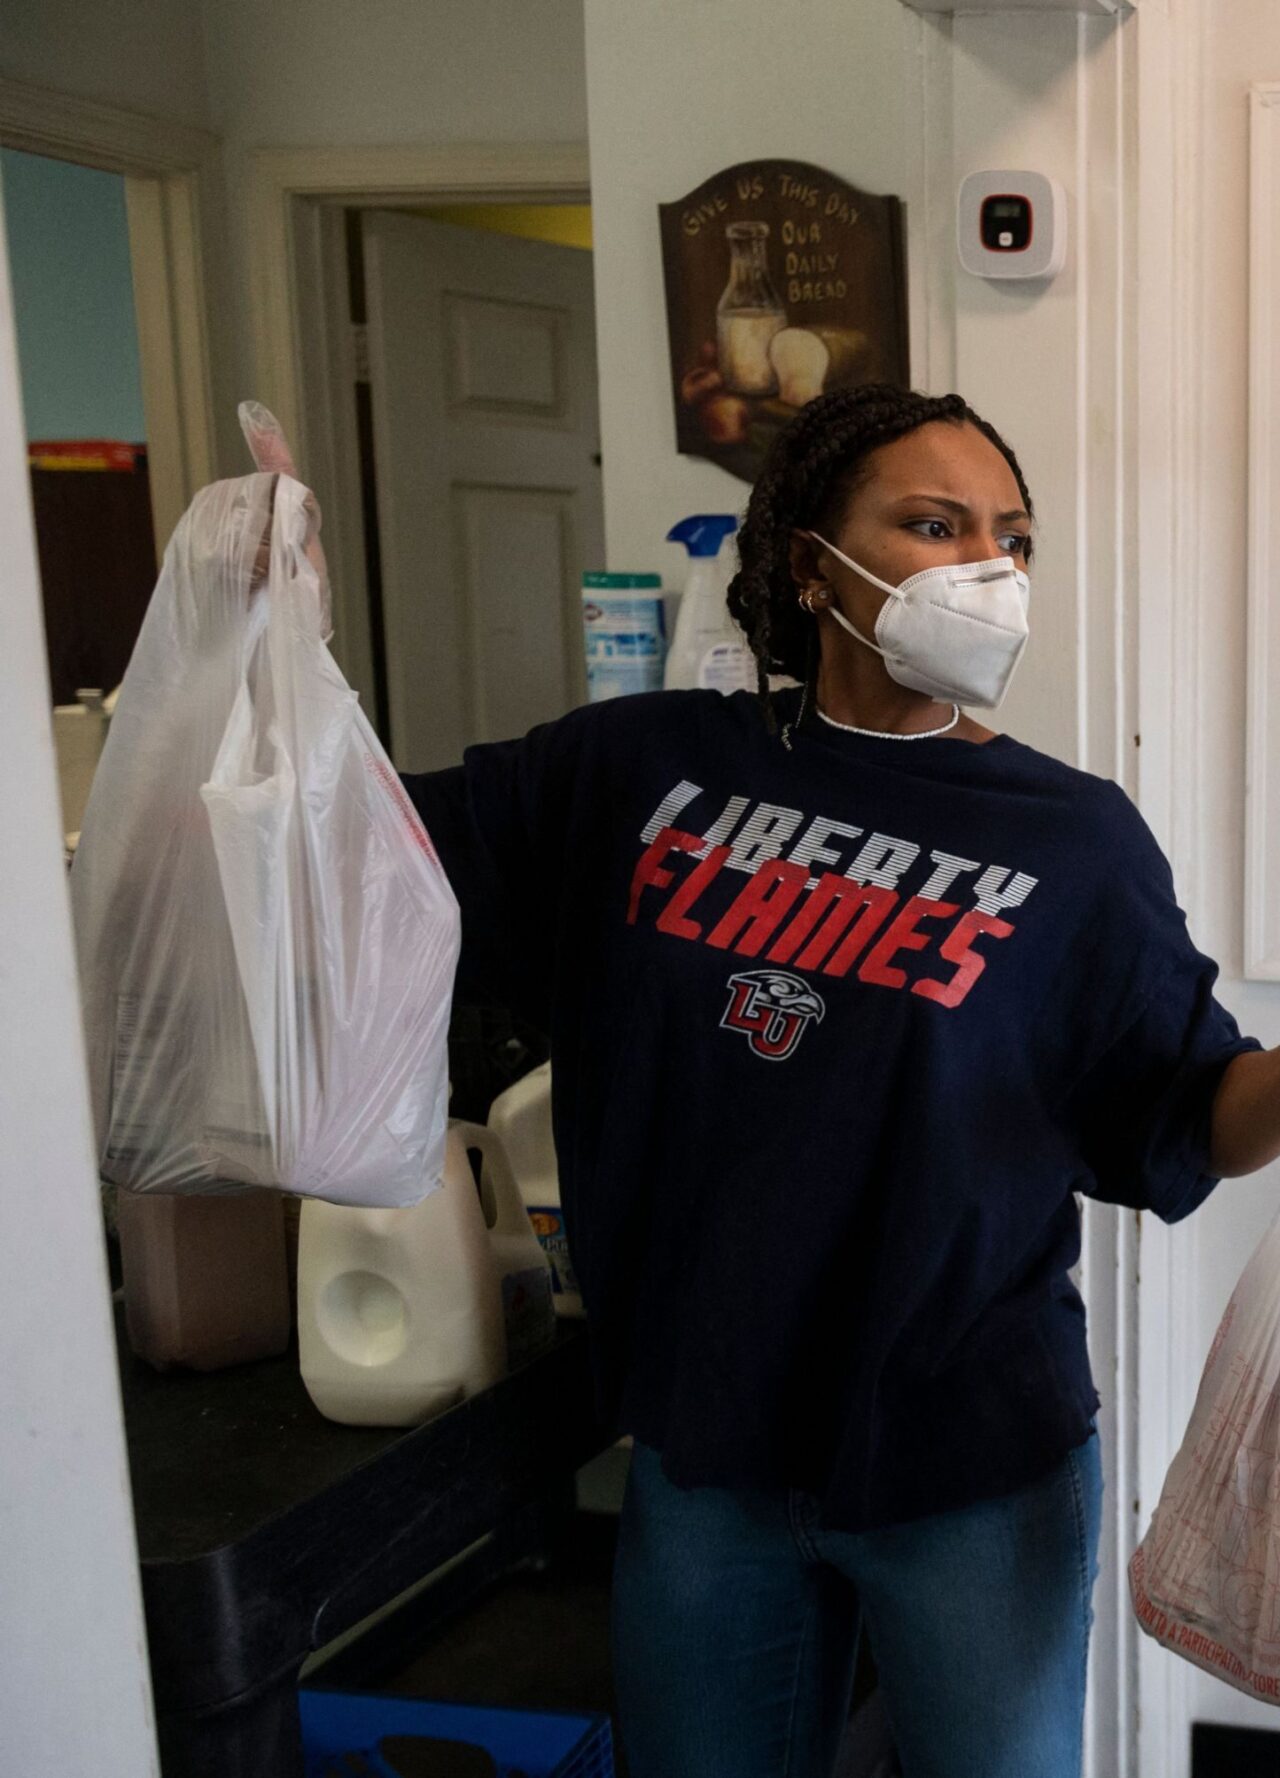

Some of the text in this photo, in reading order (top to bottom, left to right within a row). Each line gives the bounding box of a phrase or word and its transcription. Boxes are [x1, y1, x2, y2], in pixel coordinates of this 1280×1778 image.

[682, 174, 861, 236] GIVE US THIS DAY
[781, 219, 822, 245] OUR
[785, 251, 839, 275] DAILY
[788, 279, 848, 303] BREAD
[640, 779, 1039, 917] LIBERTY
[626, 826, 1015, 1009] FLAMES
